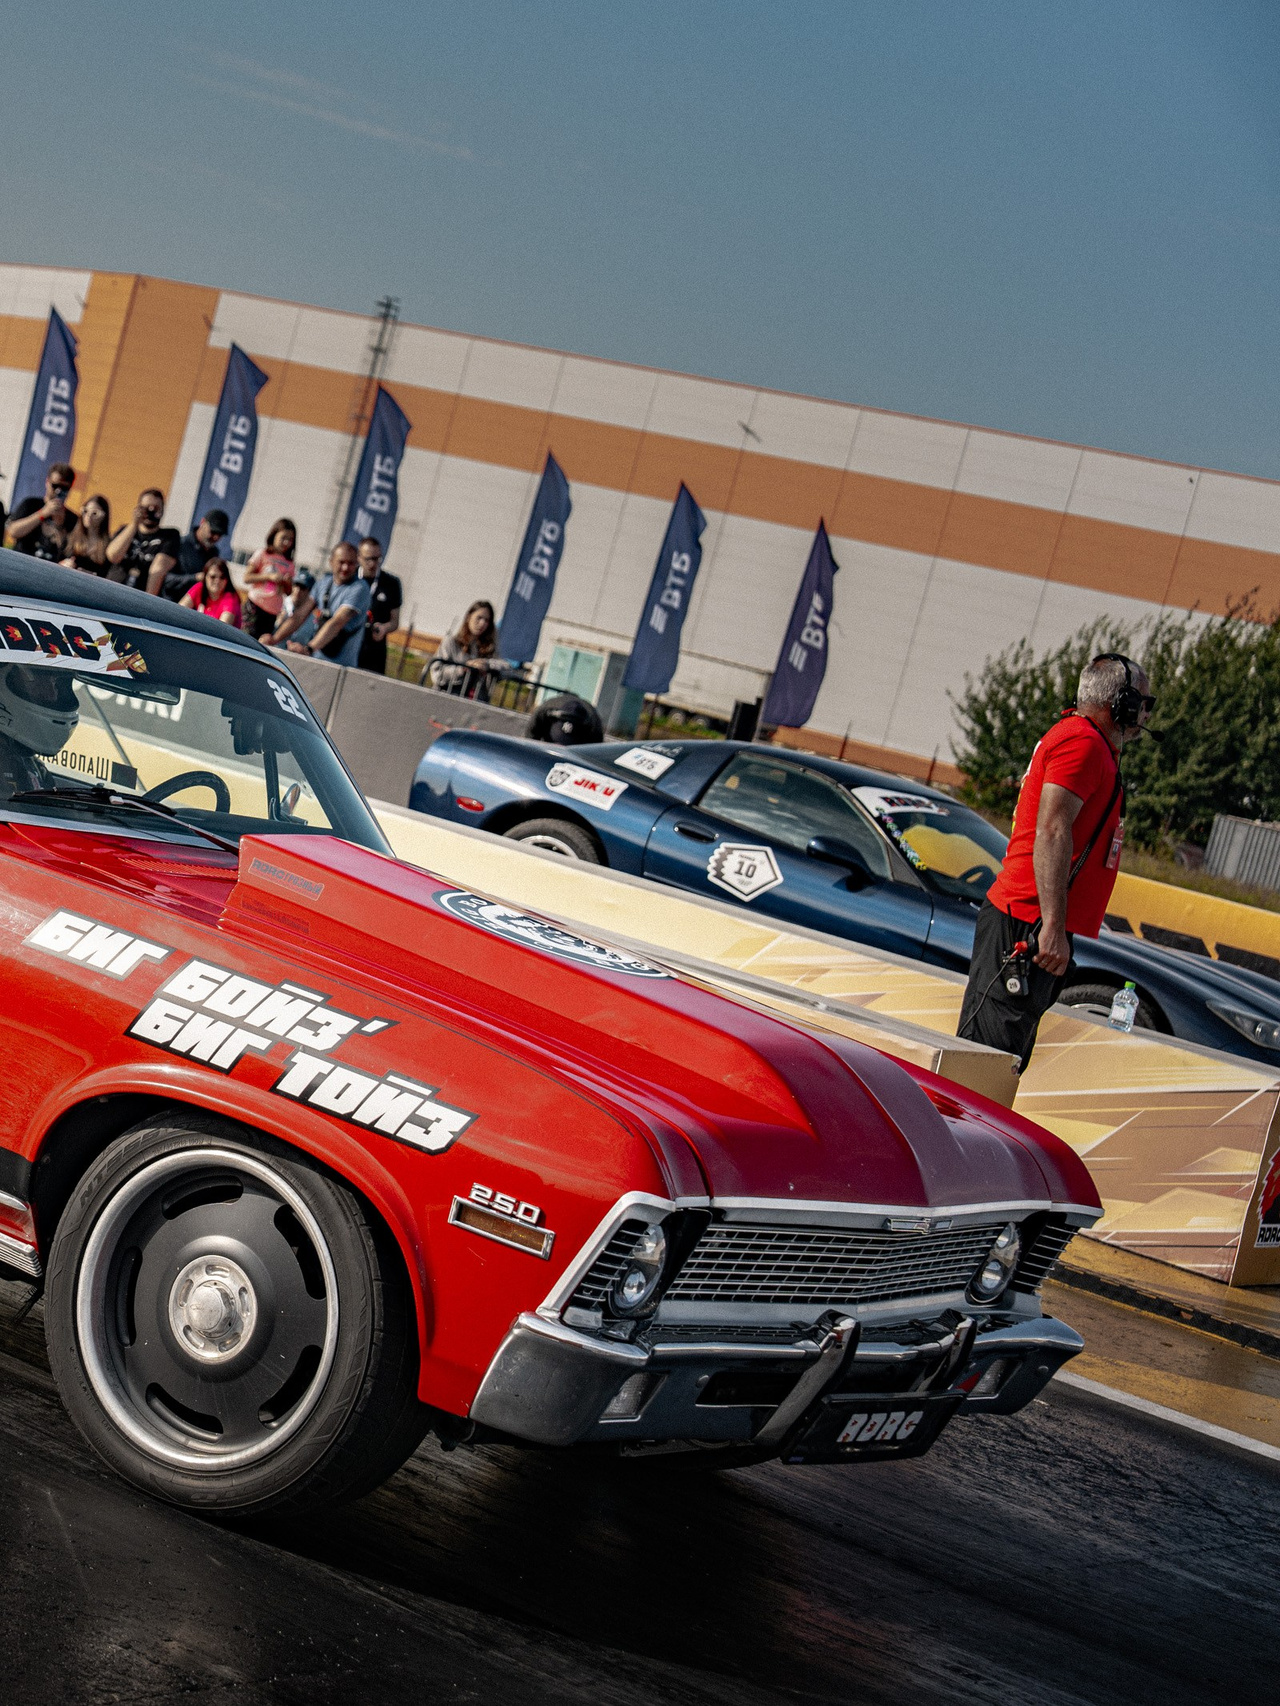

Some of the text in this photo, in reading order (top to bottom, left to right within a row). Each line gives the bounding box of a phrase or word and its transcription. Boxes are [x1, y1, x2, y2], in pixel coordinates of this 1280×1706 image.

[41, 375, 70, 436] ВТБ
[220, 414, 252, 475] ВТБ
[364, 452, 395, 515] ВТБ
[528, 517, 561, 579] ВТБ
[660, 550, 692, 610] ВТБ
[267, 678, 308, 722] 22
[733, 860, 758, 879] 10
[29, 910, 170, 977] БИГ
[129, 997, 472, 1151] БИГ ТОЙЗ
[835, 1410, 924, 1443] RDRC
